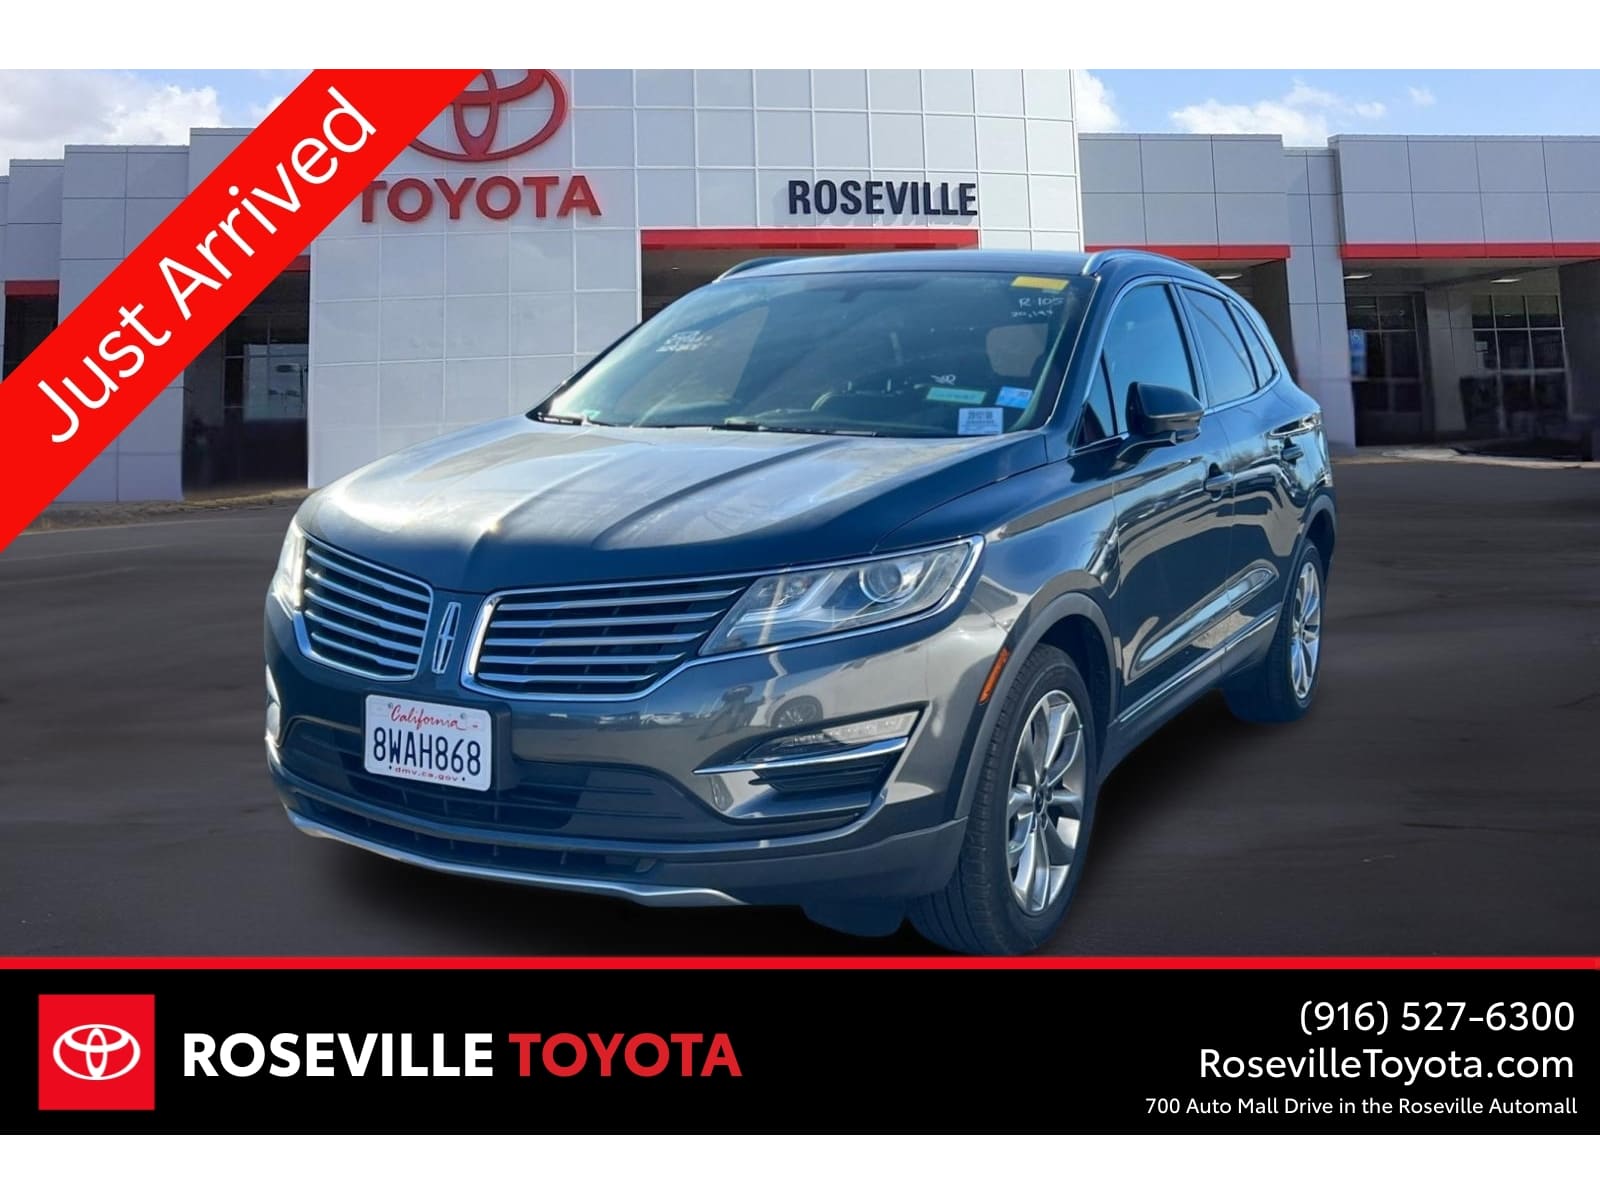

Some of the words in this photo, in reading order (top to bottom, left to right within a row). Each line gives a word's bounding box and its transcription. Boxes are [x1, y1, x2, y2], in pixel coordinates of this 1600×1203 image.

[361, 175, 602, 223] TOYOTA
[788, 179, 978, 216] ROSEVILLE
[390, 704, 467, 731] California
[373, 726, 481, 777] 8WAH868
[394, 766, 459, 782] dmv.ca.gov
